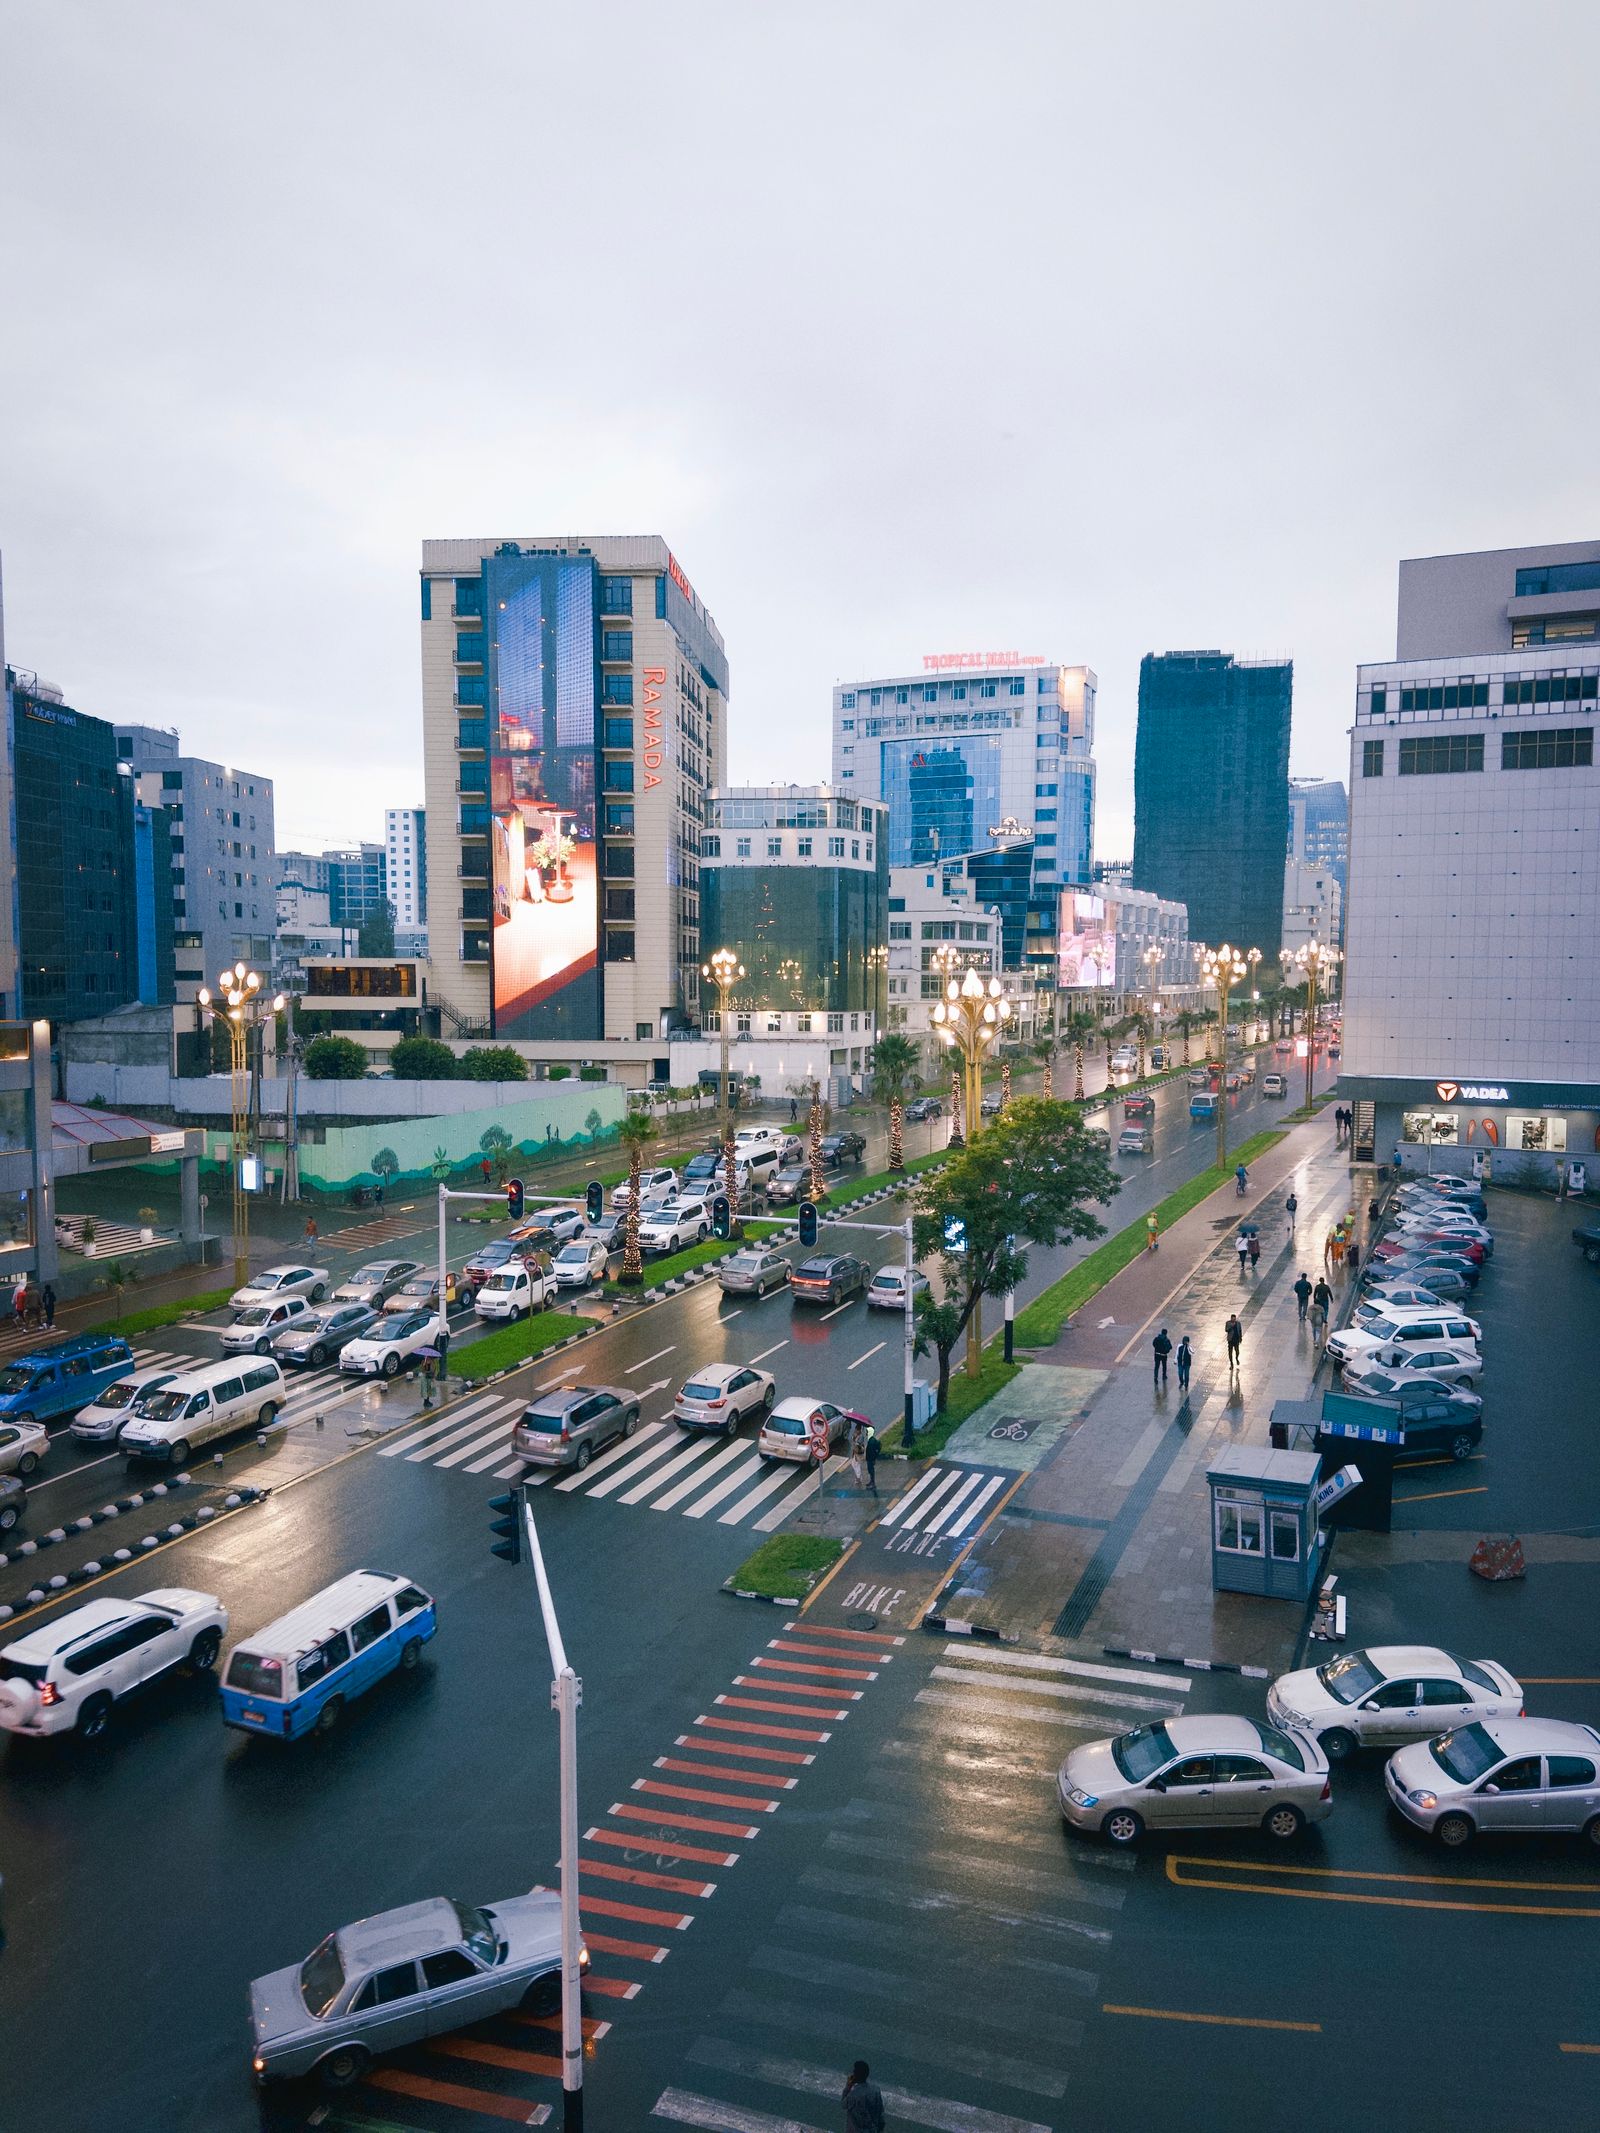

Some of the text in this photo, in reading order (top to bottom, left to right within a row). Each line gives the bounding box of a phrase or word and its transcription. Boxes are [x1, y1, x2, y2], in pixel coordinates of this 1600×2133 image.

[923, 652, 983, 669] TROPICAL
[986, 651, 1019, 666] MALL
[643, 667, 666, 790] RAMADA
[1460, 1086, 1509, 1100] YADEA
[1317, 1485, 1334, 1503] KING
[883, 1529, 948, 1557] LANE
[841, 1582, 907, 1616] BIKE
